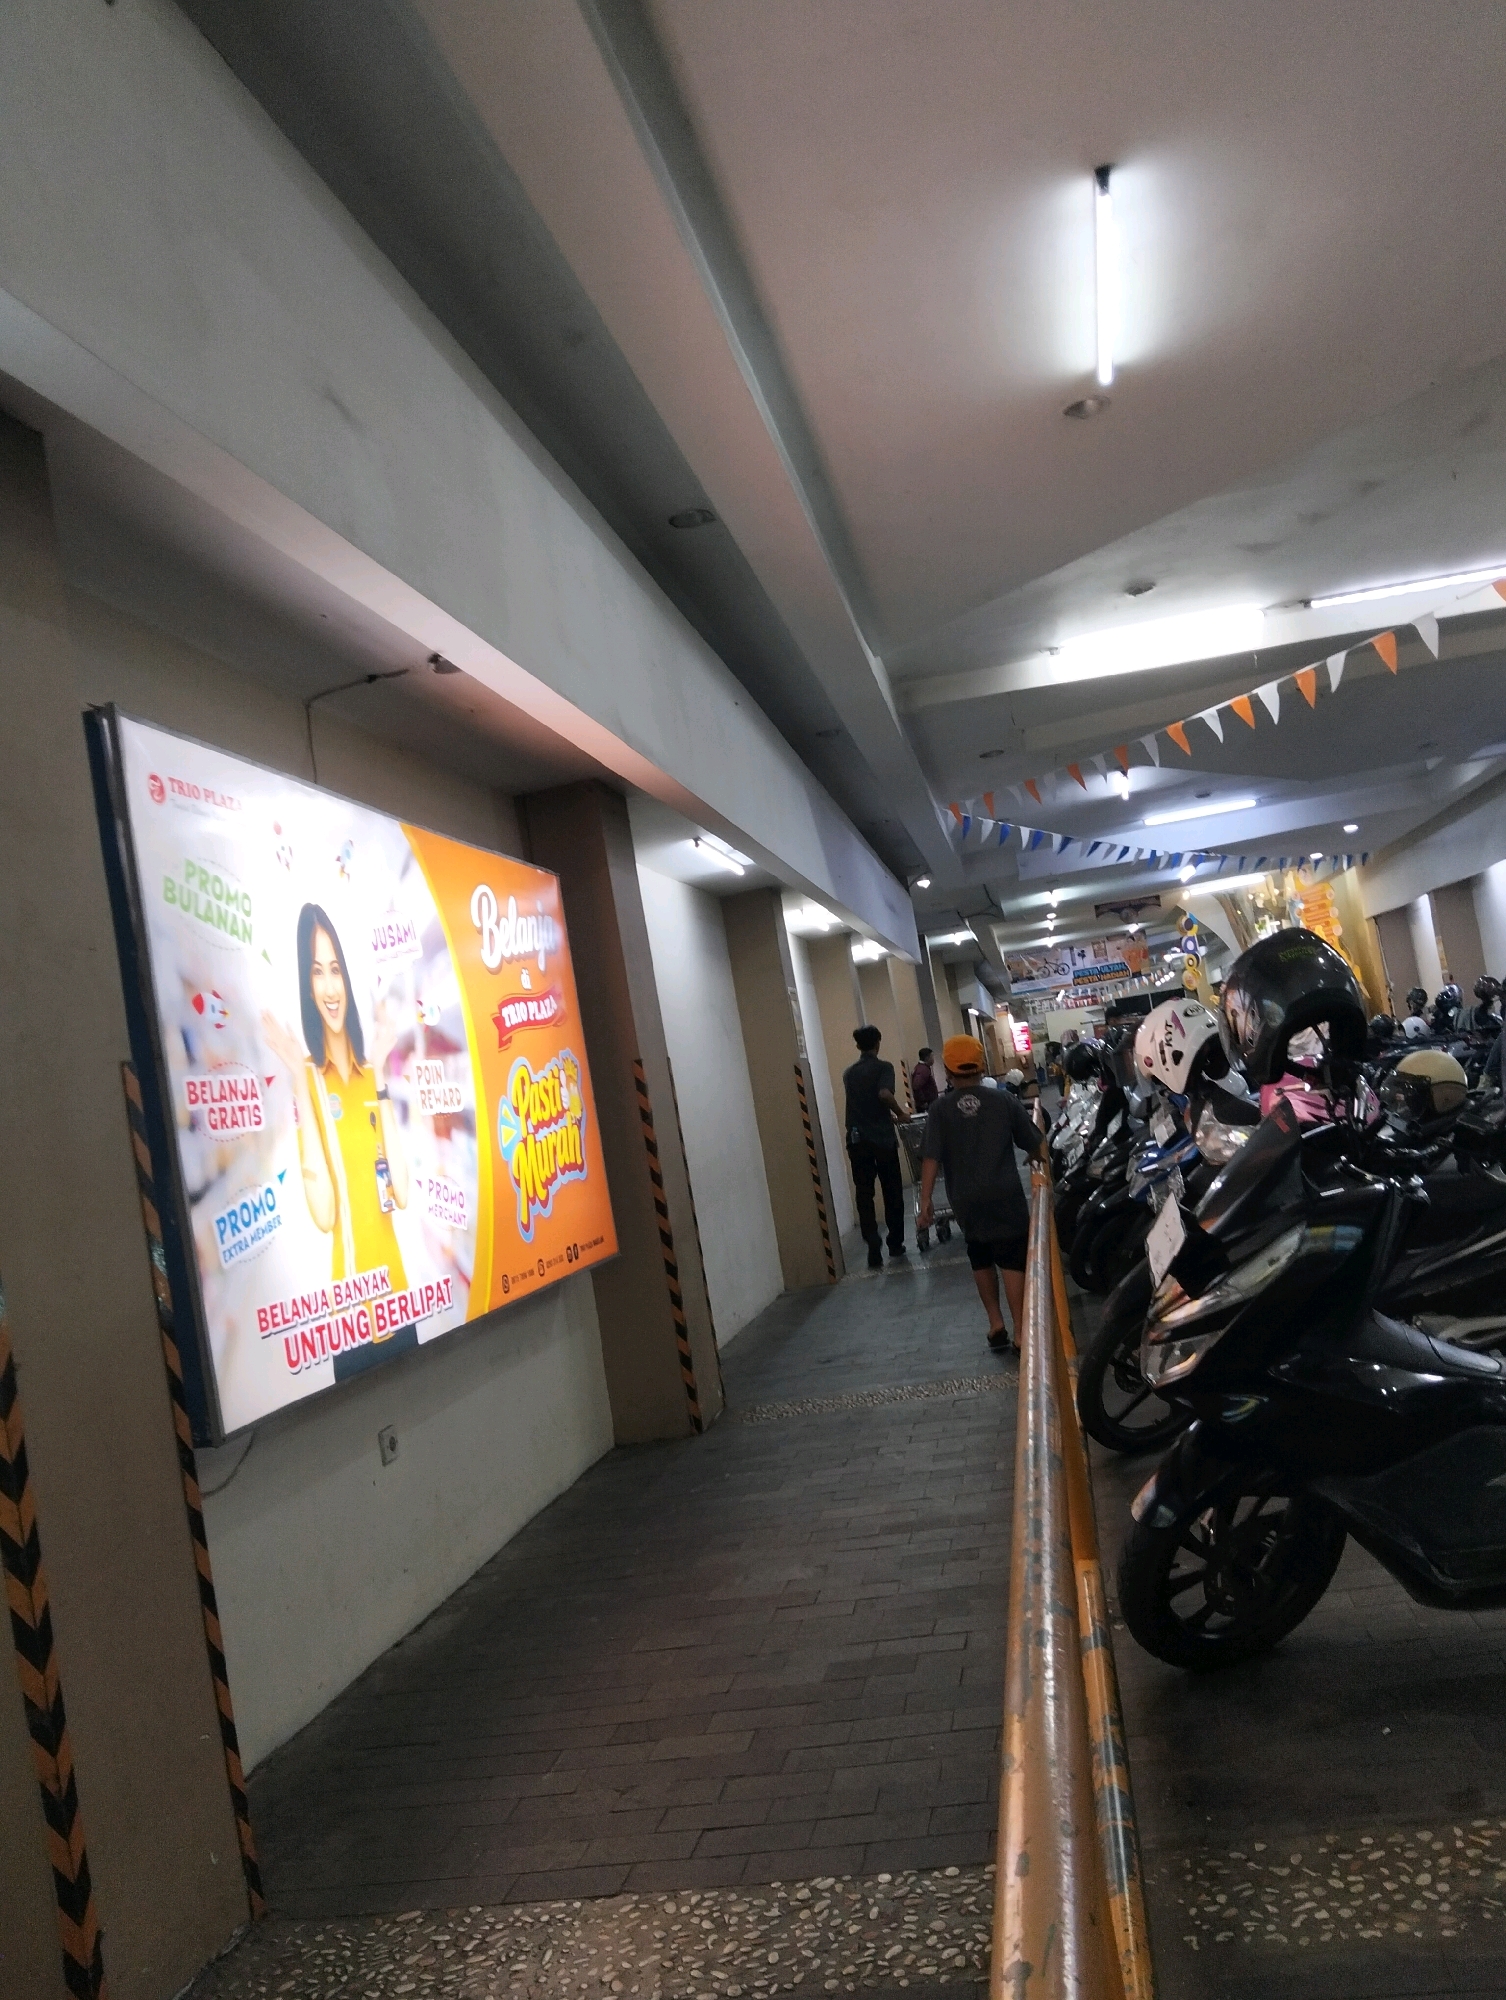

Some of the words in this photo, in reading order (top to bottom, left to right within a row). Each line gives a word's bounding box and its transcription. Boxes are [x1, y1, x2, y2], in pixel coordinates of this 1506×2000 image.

[167, 776, 200, 800] TRIO
[184, 858, 252, 918] PROMO
[162, 875, 252, 946] BULANAN
[371, 919, 417, 952] JUSAMI
[501, 1000, 528, 1028] TRIO
[527, 994, 558, 1022] PLAZA
[1165, 1019, 1173, 1048] KYT
[185, 1078, 260, 1106] BELANJA
[415, 1064, 443, 1086] POIN
[419, 1087, 462, 1110] REWARD
[511, 1064, 563, 1139] Pasti
[208, 1103, 263, 1131] GRATIS
[512, 1122, 583, 1225] Murah
[428, 1178, 465, 1209] PROMO
[215, 1186, 277, 1246] PROMO
[222, 1235, 250, 1264] EXTRA
[250, 1214, 283, 1248] MEMBER
[256, 1289, 330, 1333] BELANJA
[332, 1268, 390, 1307] BANYAK
[283, 1308, 372, 1369] UNTUNG
[374, 1277, 453, 1333] BERLIPAT
